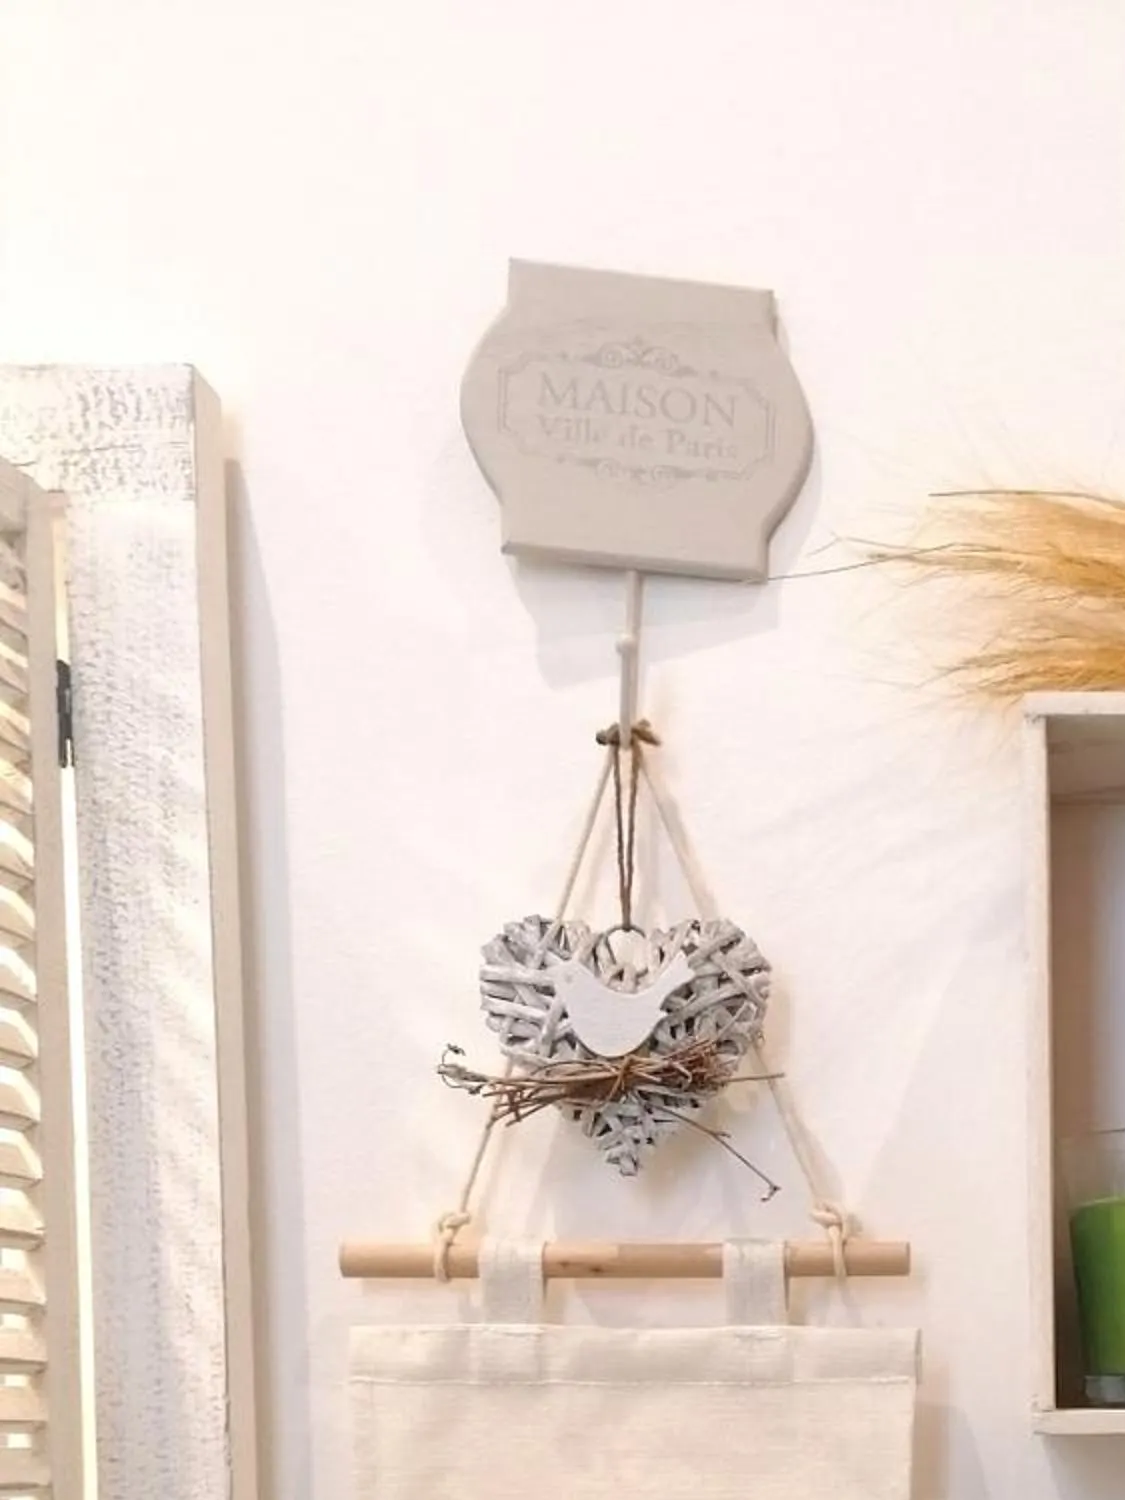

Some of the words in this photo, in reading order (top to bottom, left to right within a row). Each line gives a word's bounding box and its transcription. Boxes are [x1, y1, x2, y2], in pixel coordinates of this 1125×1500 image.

[537, 370, 738, 428] MAISON
[535, 413, 607, 443] Ville
[619, 423, 655, 450] de
[665, 427, 739, 460] Paris
